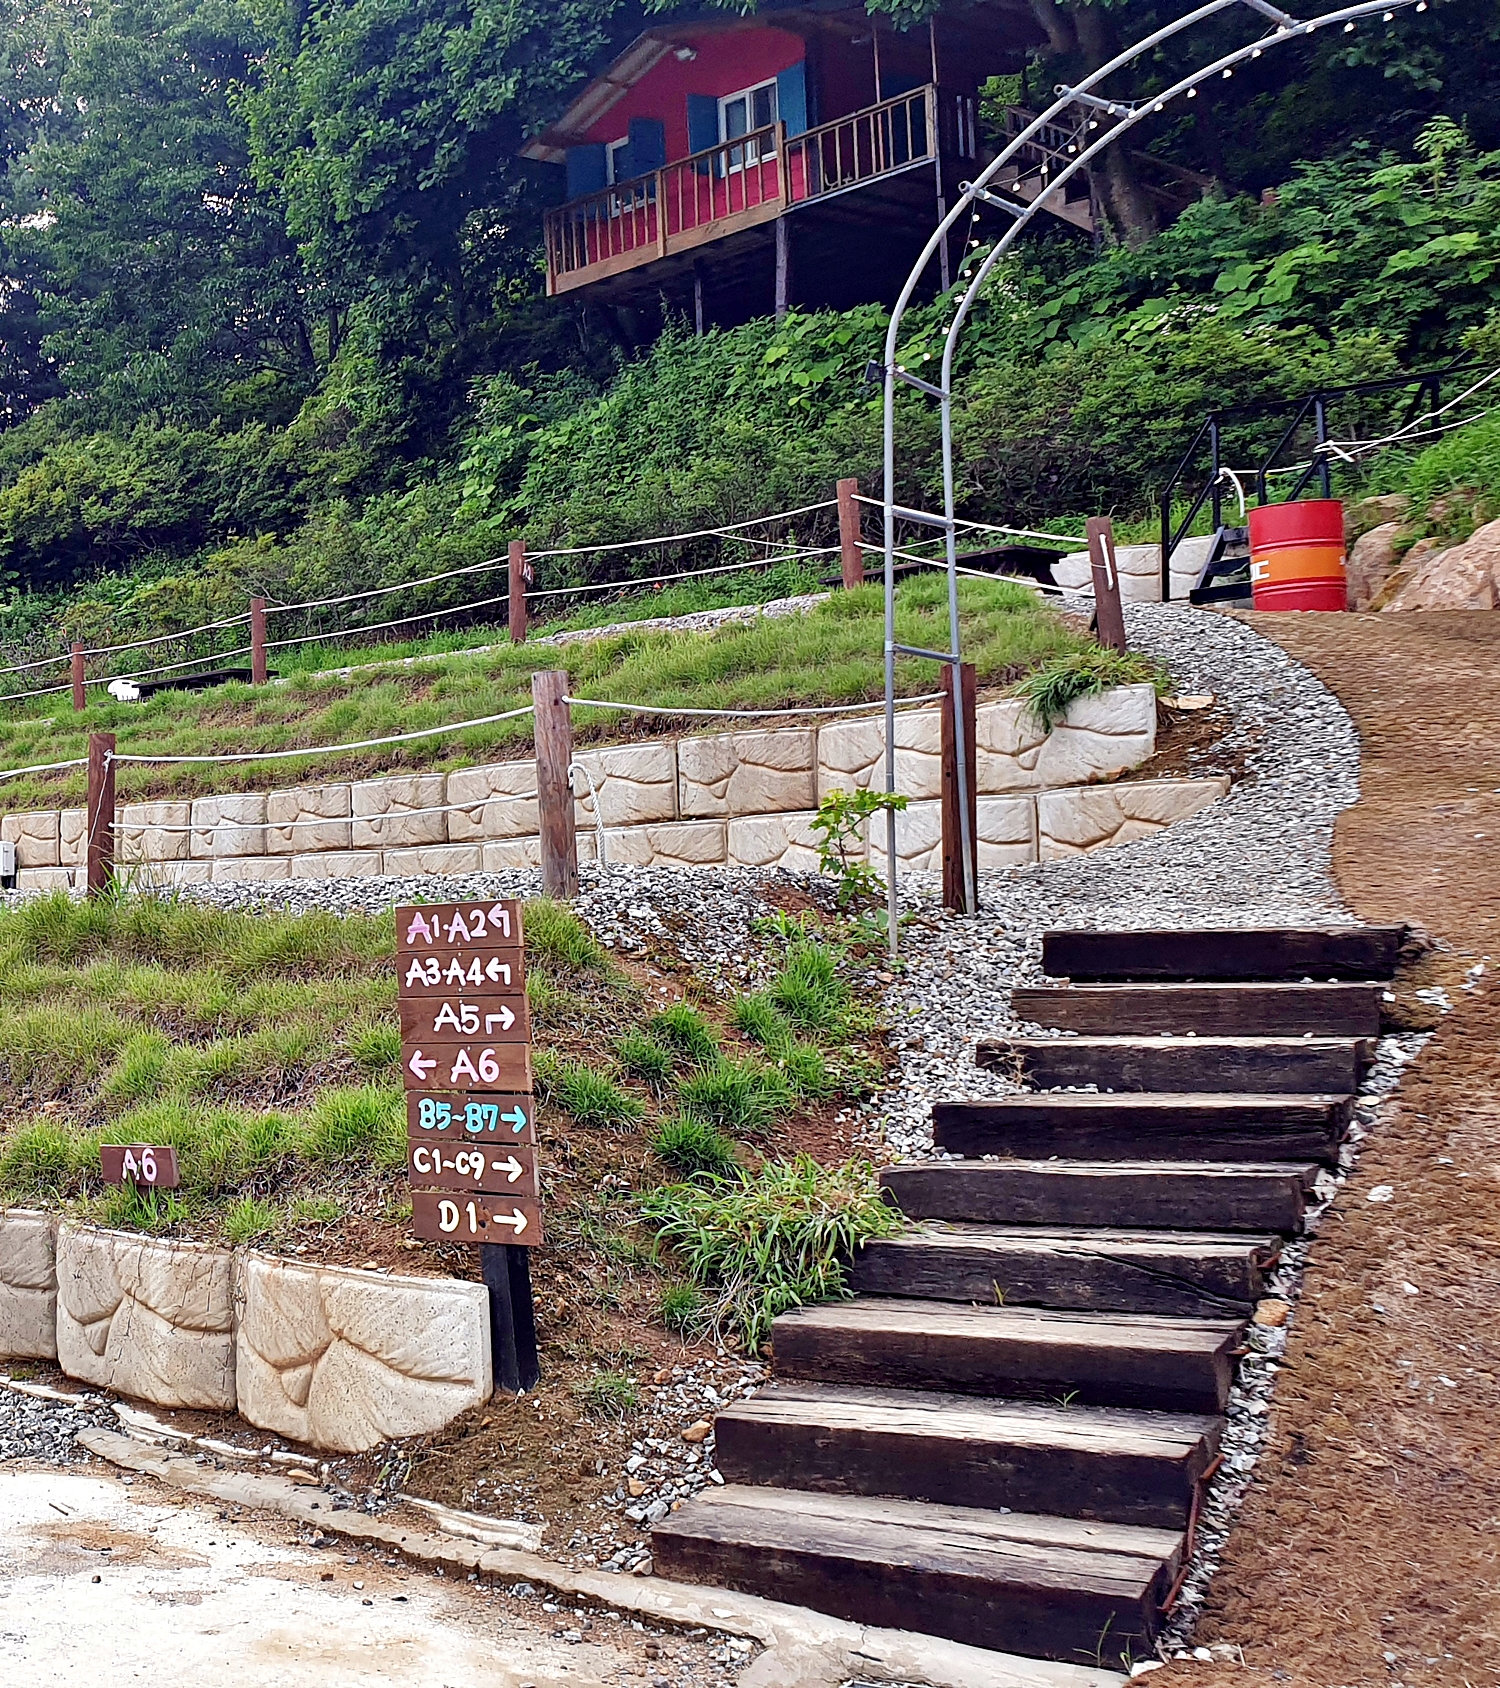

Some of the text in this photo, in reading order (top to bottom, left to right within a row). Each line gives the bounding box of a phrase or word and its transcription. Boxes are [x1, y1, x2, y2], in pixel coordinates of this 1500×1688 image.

[434, 1003, 480, 1035] A5
[451, 1049, 500, 1083] A6
[418, 1098, 499, 1133] B5~B7
[413, 1147, 485, 1181] C1~C9
